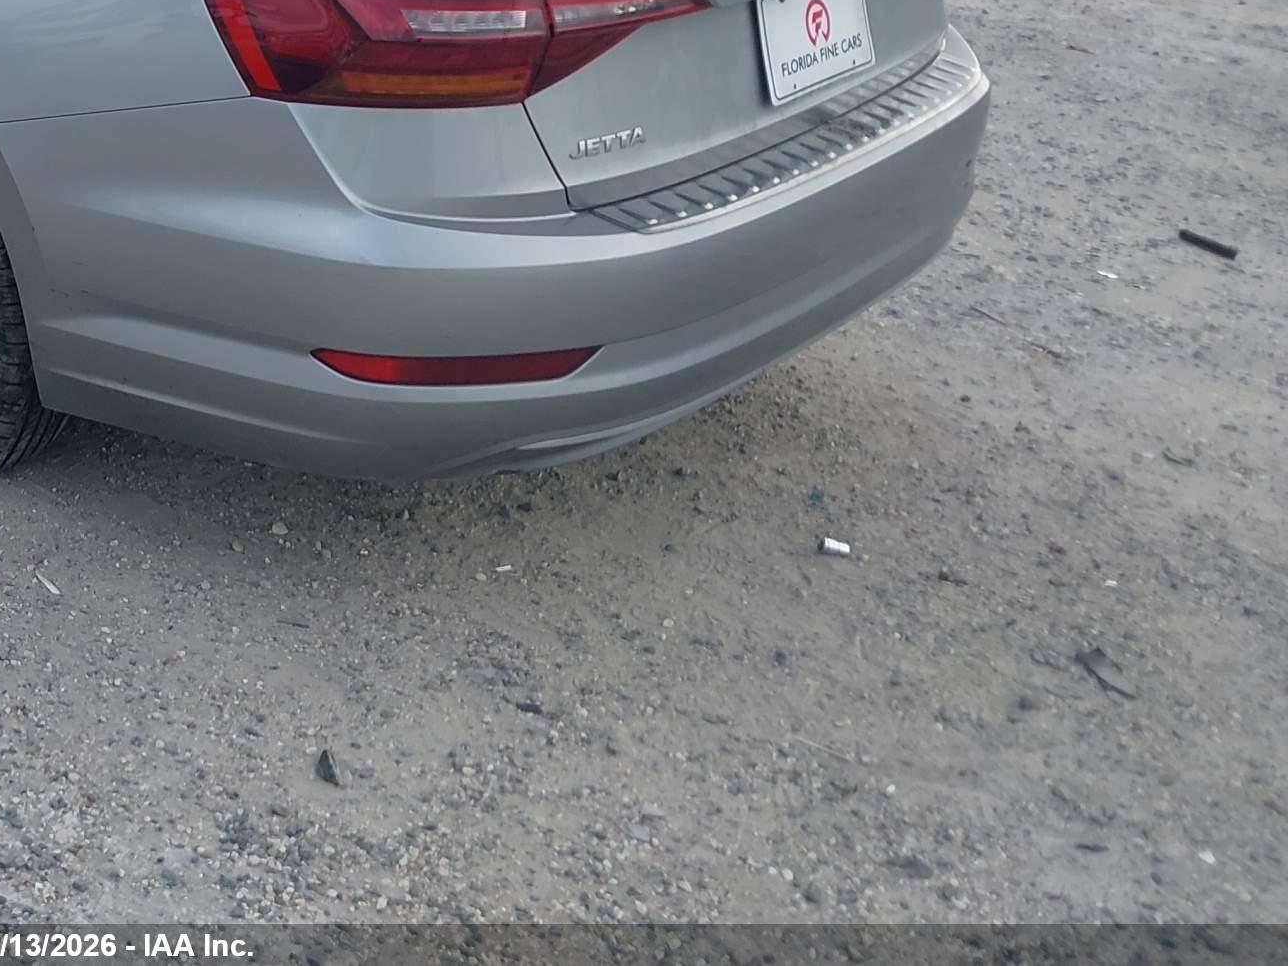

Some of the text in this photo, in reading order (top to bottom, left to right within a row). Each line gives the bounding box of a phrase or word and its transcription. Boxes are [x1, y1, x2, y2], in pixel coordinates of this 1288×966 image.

[781, 34, 863, 77] FLORIDA FINE CARS
[569, 126, 646, 160] JETTA
